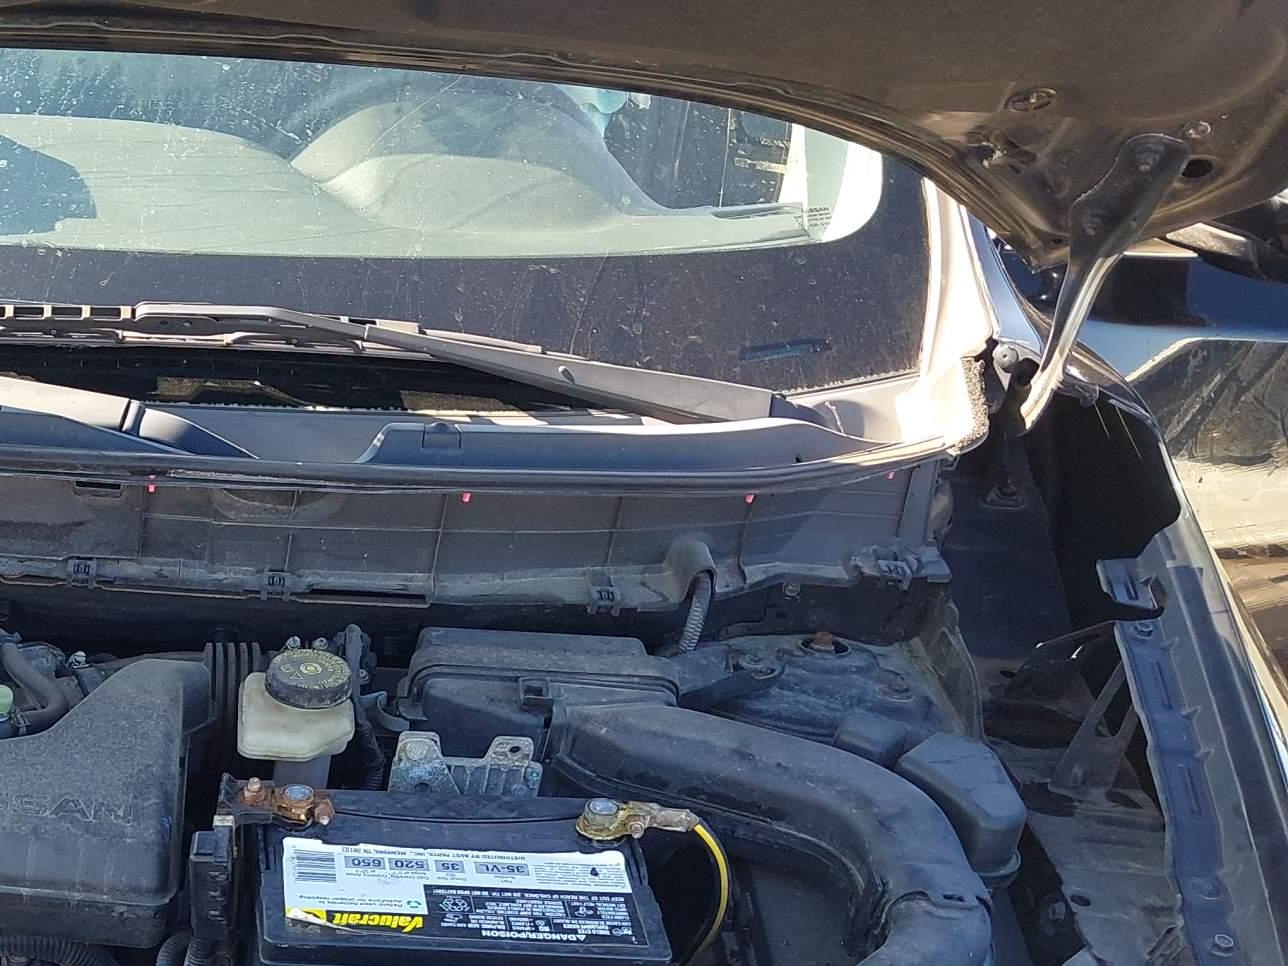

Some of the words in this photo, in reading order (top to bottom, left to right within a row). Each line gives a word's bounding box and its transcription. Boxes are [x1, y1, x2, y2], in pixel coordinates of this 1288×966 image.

[351, 858, 381, 867] 650
[394, 860, 424, 869] 520
[441, 862, 460, 871] 35
[479, 864, 525, 873] 35-VL
[332, 912, 423, 933] Valucraft
